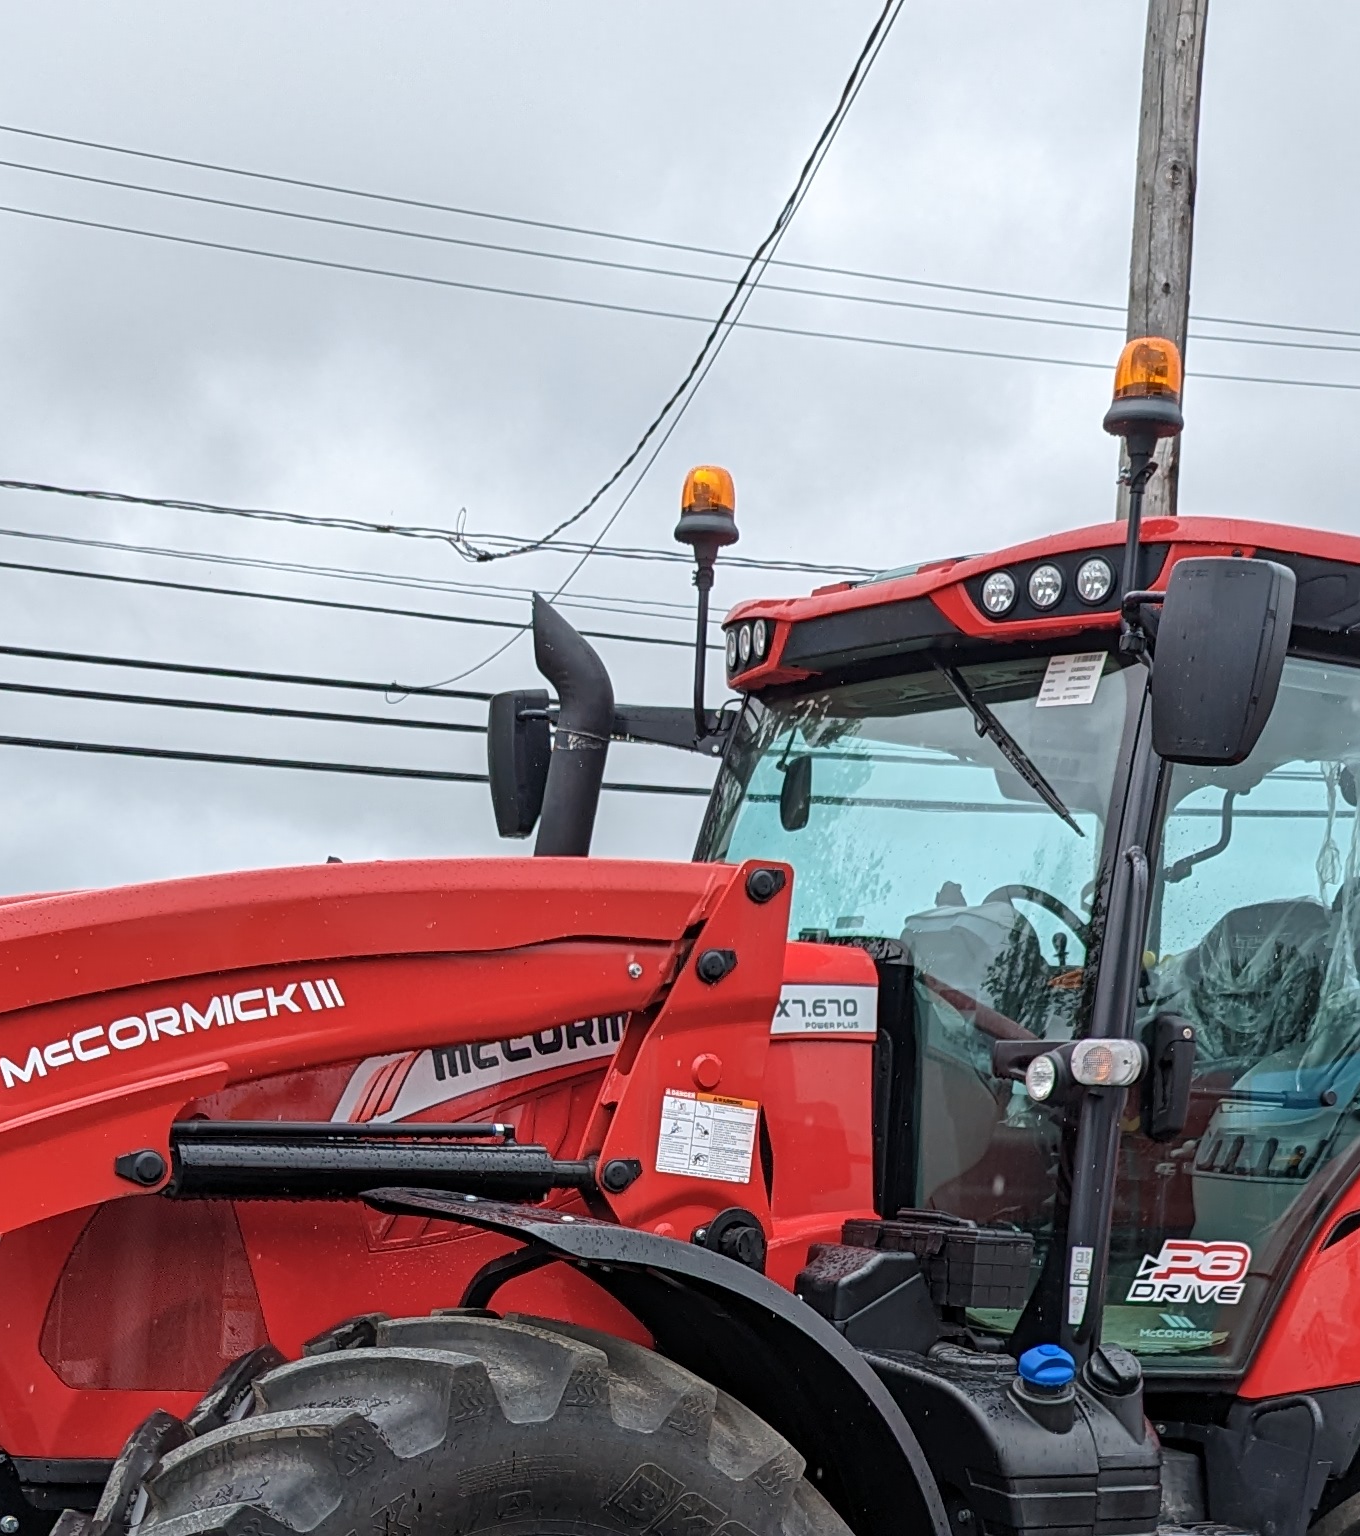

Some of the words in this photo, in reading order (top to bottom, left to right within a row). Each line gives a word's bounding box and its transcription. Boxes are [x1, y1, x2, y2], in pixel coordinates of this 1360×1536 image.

[776, 998, 858, 1018] X7.670
[805, 1021, 835, 1029] POWER
[836, 1021, 859, 1029] PLUS
[1151, 1242, 1249, 1282] P6
[1130, 1282, 1242, 1301] DRIVE
[1139, 1328, 1214, 1340] McCORMICK
